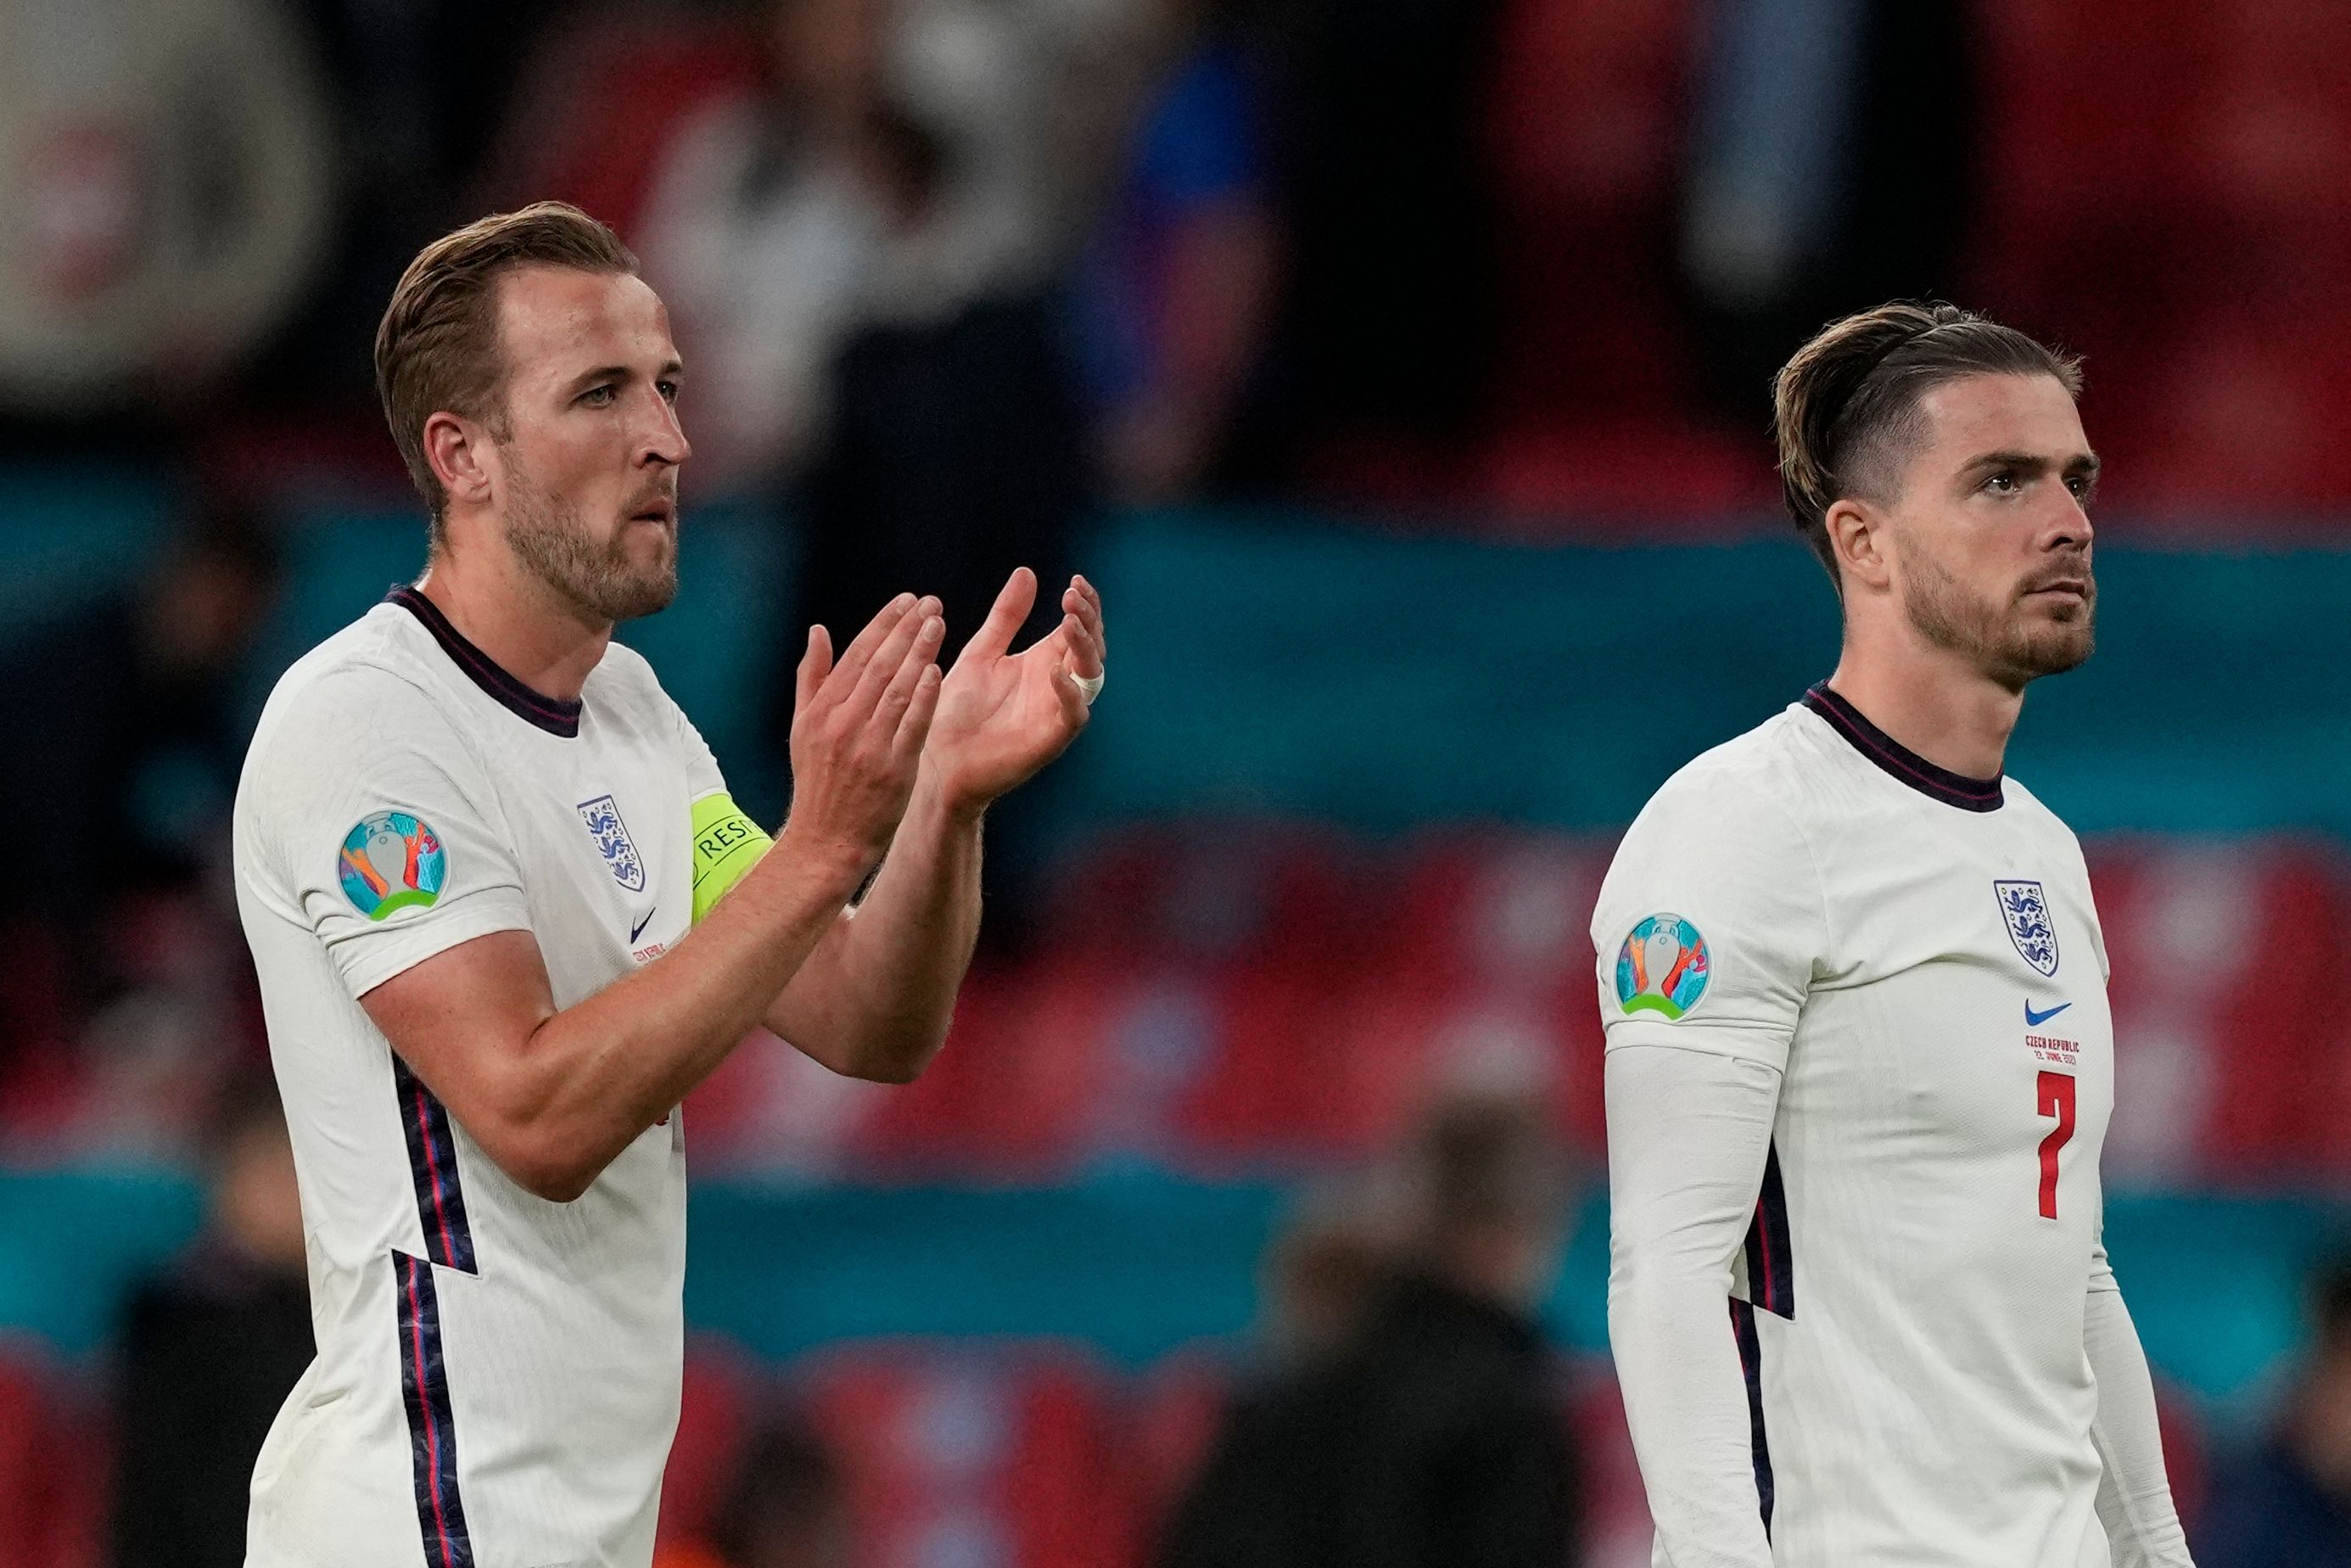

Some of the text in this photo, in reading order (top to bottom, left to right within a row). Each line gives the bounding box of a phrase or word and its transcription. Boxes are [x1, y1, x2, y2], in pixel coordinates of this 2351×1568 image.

[2025, 1035, 2080, 1053] CZECH REPUBLIC
[2037, 1070, 2076, 1221] 7
